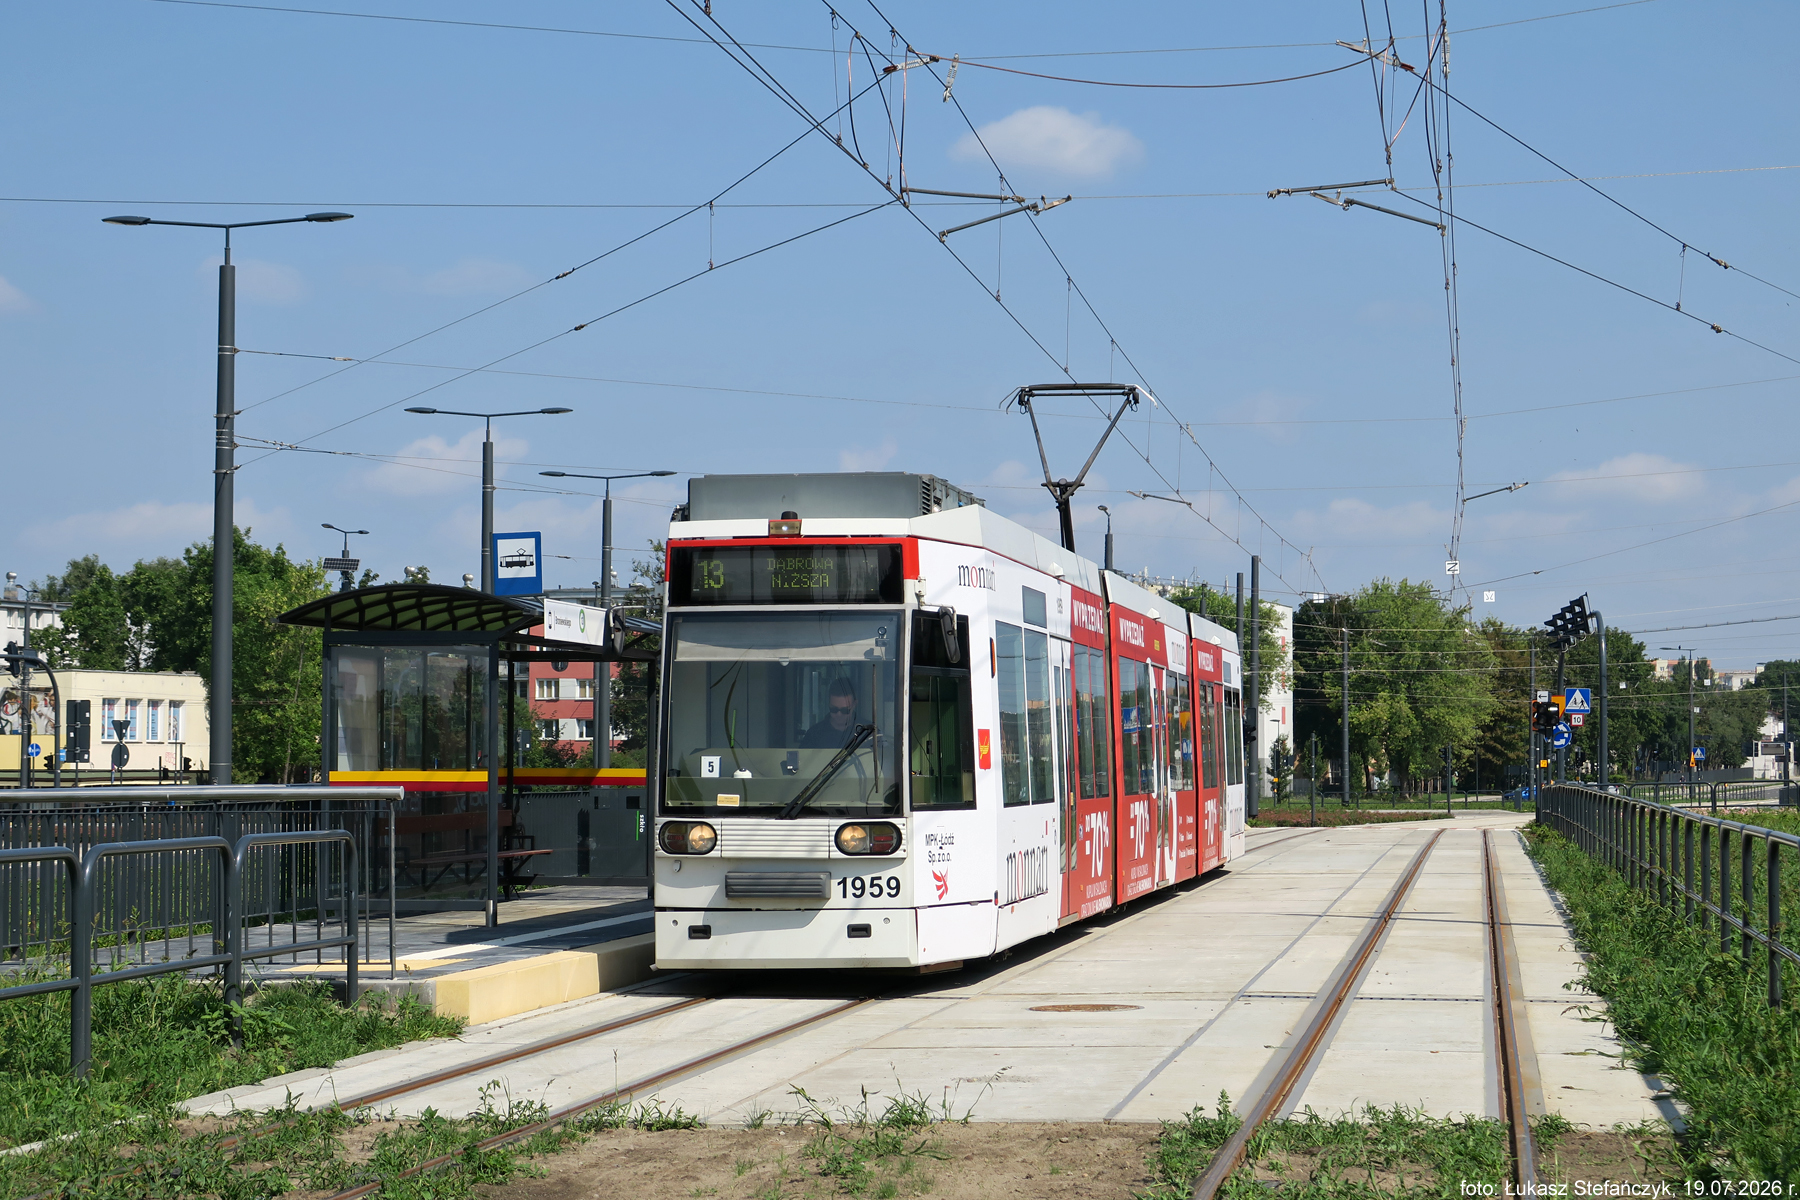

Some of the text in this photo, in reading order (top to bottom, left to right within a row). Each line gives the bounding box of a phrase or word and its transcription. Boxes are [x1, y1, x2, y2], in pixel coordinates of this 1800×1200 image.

[698, 557, 834, 589] 13 DĄBROWA
[1073, 599, 1104, 634] WYPRZEDAŻ
[1119, 618, 1145, 648] WYPRZEDAŻ
[1573, 716, 1581, 724] 10
[707, 761, 715, 774] 5
[1085, 811, 1110, 878] -70%
[1006, 820, 1048, 903] monnari
[837, 876, 901, 899] 1959
